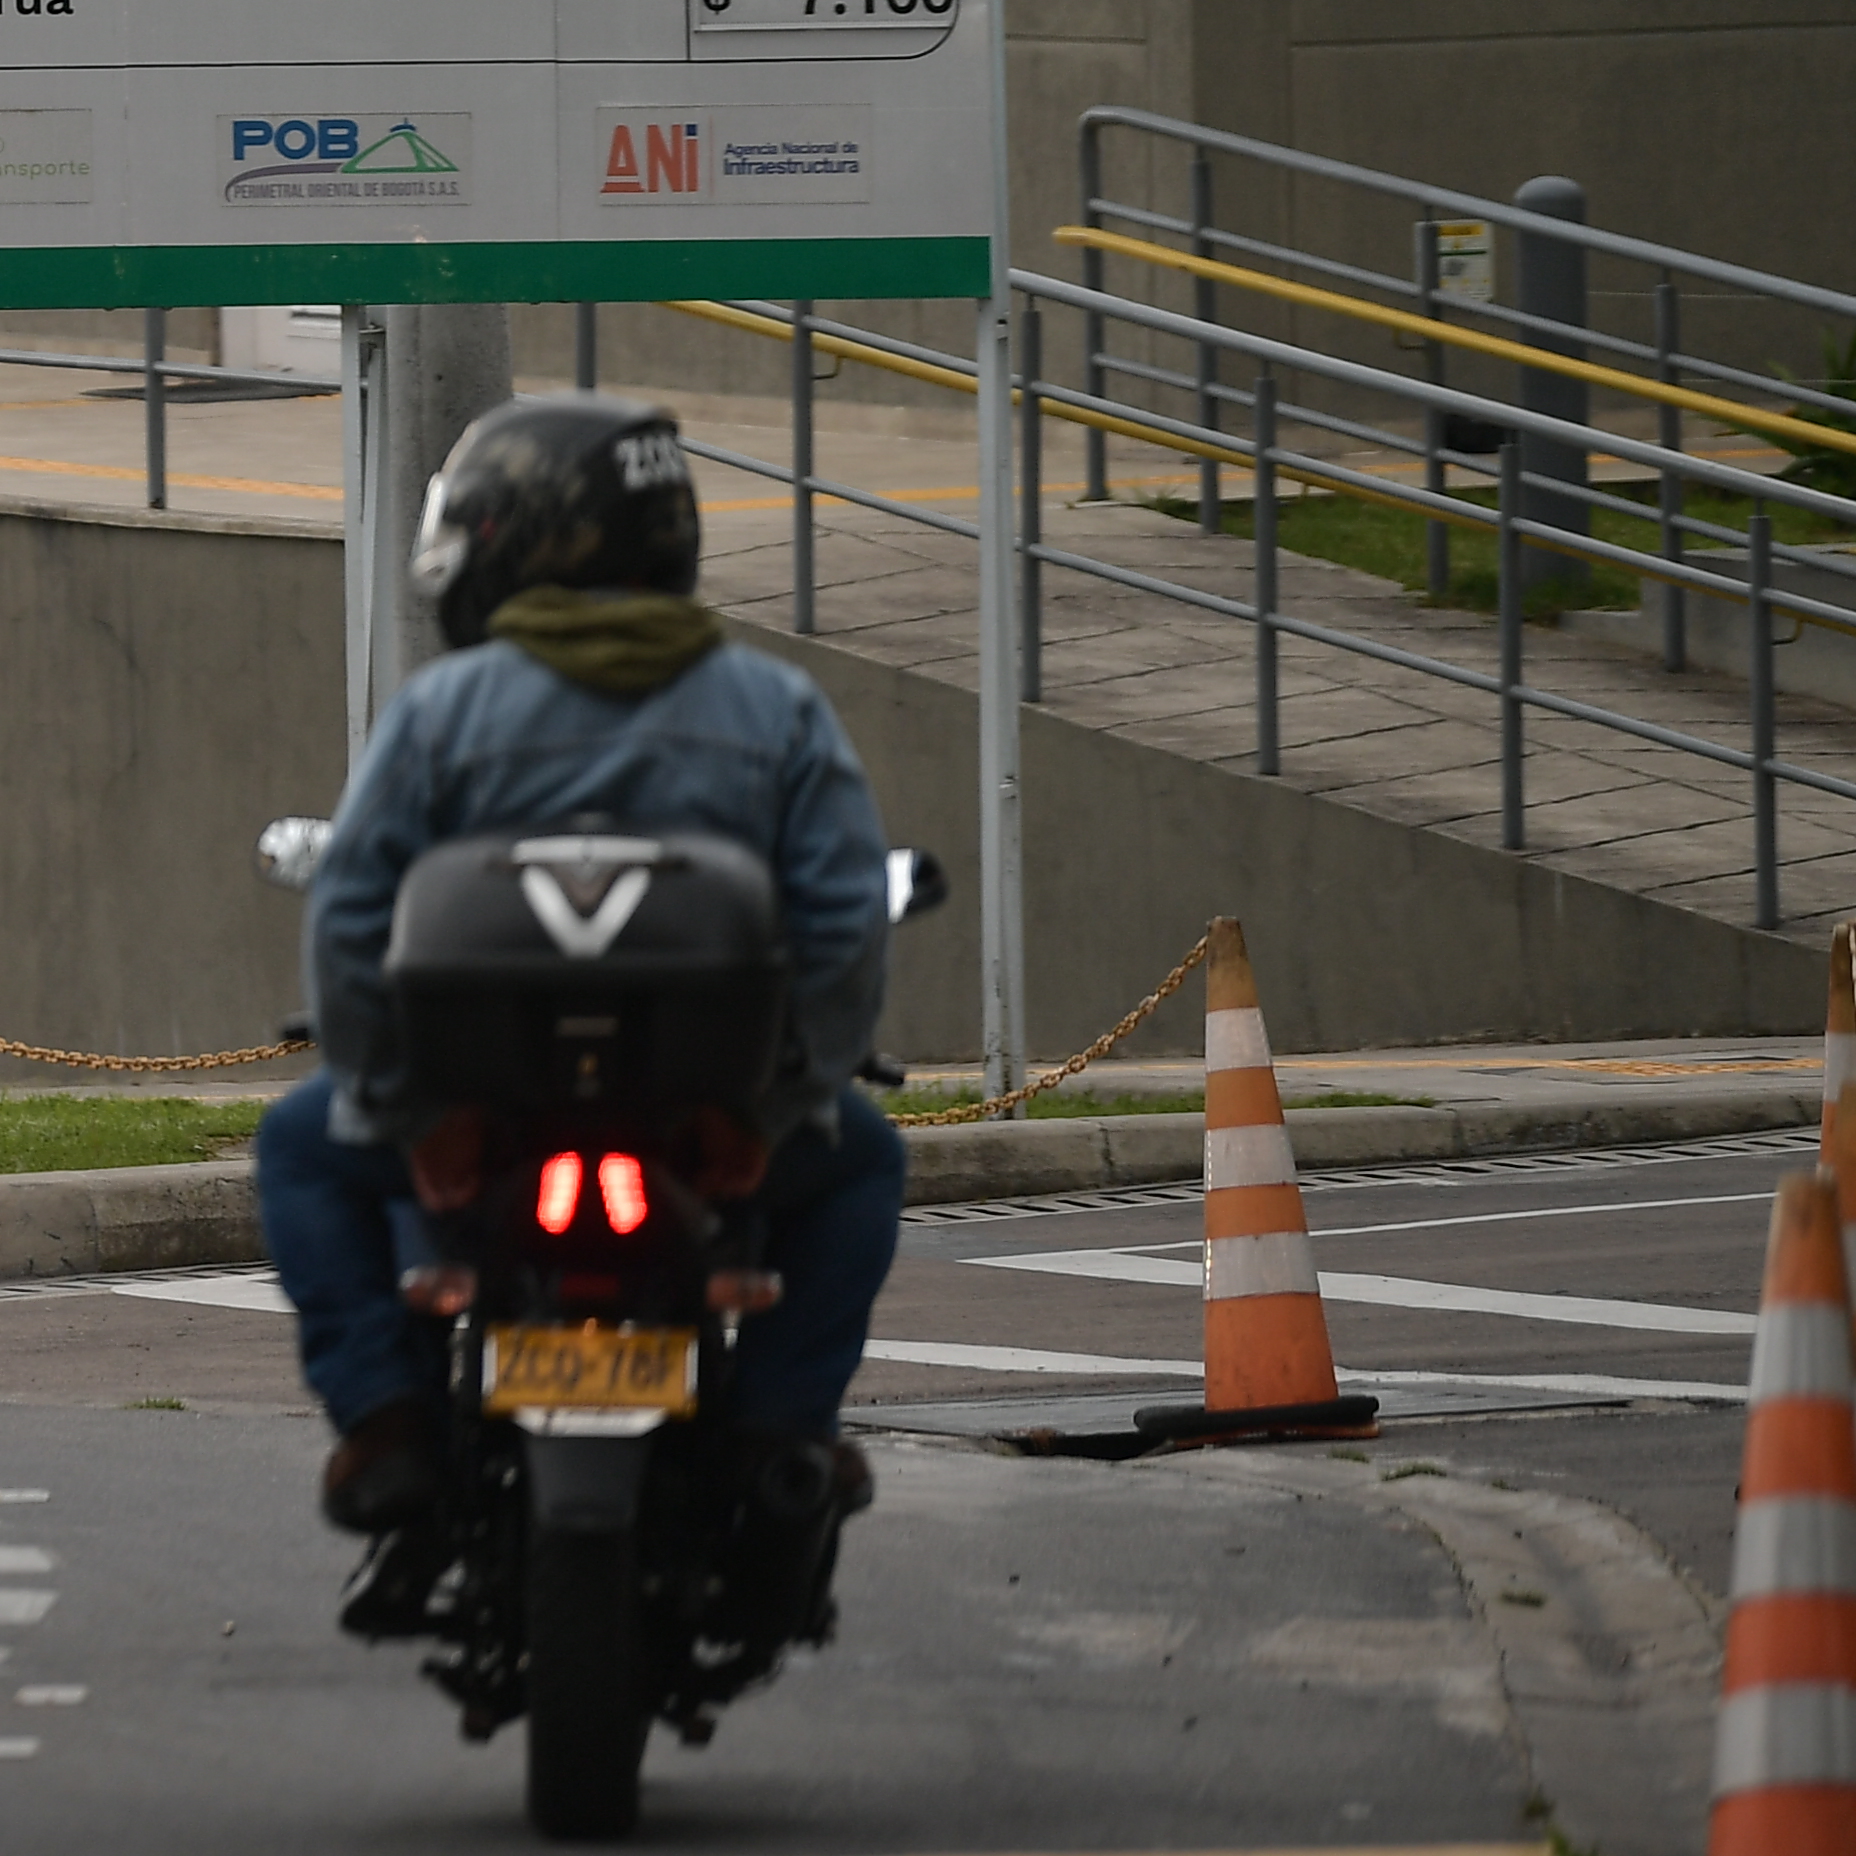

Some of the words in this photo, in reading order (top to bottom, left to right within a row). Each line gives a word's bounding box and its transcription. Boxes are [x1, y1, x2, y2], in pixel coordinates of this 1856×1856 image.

[233, 119, 359, 160] POB
[724, 142, 778, 158] Agencia
[782, 141, 838, 155] Nacional
[724, 157, 860, 176] Infraestructura
